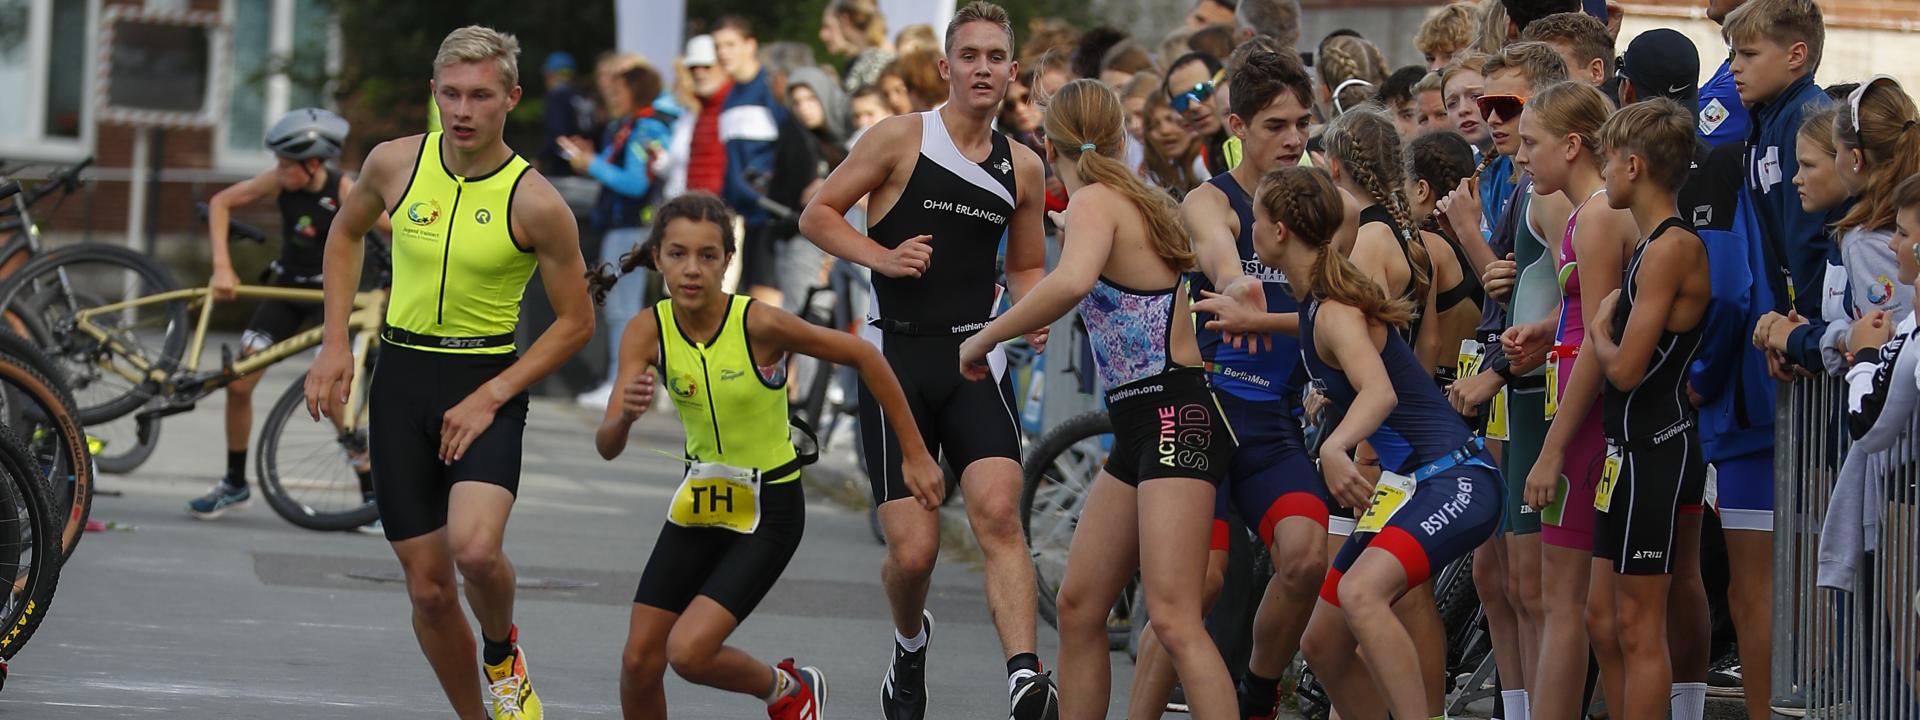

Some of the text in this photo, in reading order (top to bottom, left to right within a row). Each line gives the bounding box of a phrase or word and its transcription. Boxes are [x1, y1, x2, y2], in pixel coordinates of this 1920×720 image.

[923, 199, 1007, 225] OHM ERLANGEN
[1223, 367, 1271, 388] BerlinMan
[1158, 405, 1176, 468] ACTIVE
[1177, 403, 1212, 471] SQD
[691, 485, 733, 514] TH
[1420, 508, 1450, 537] BSV
